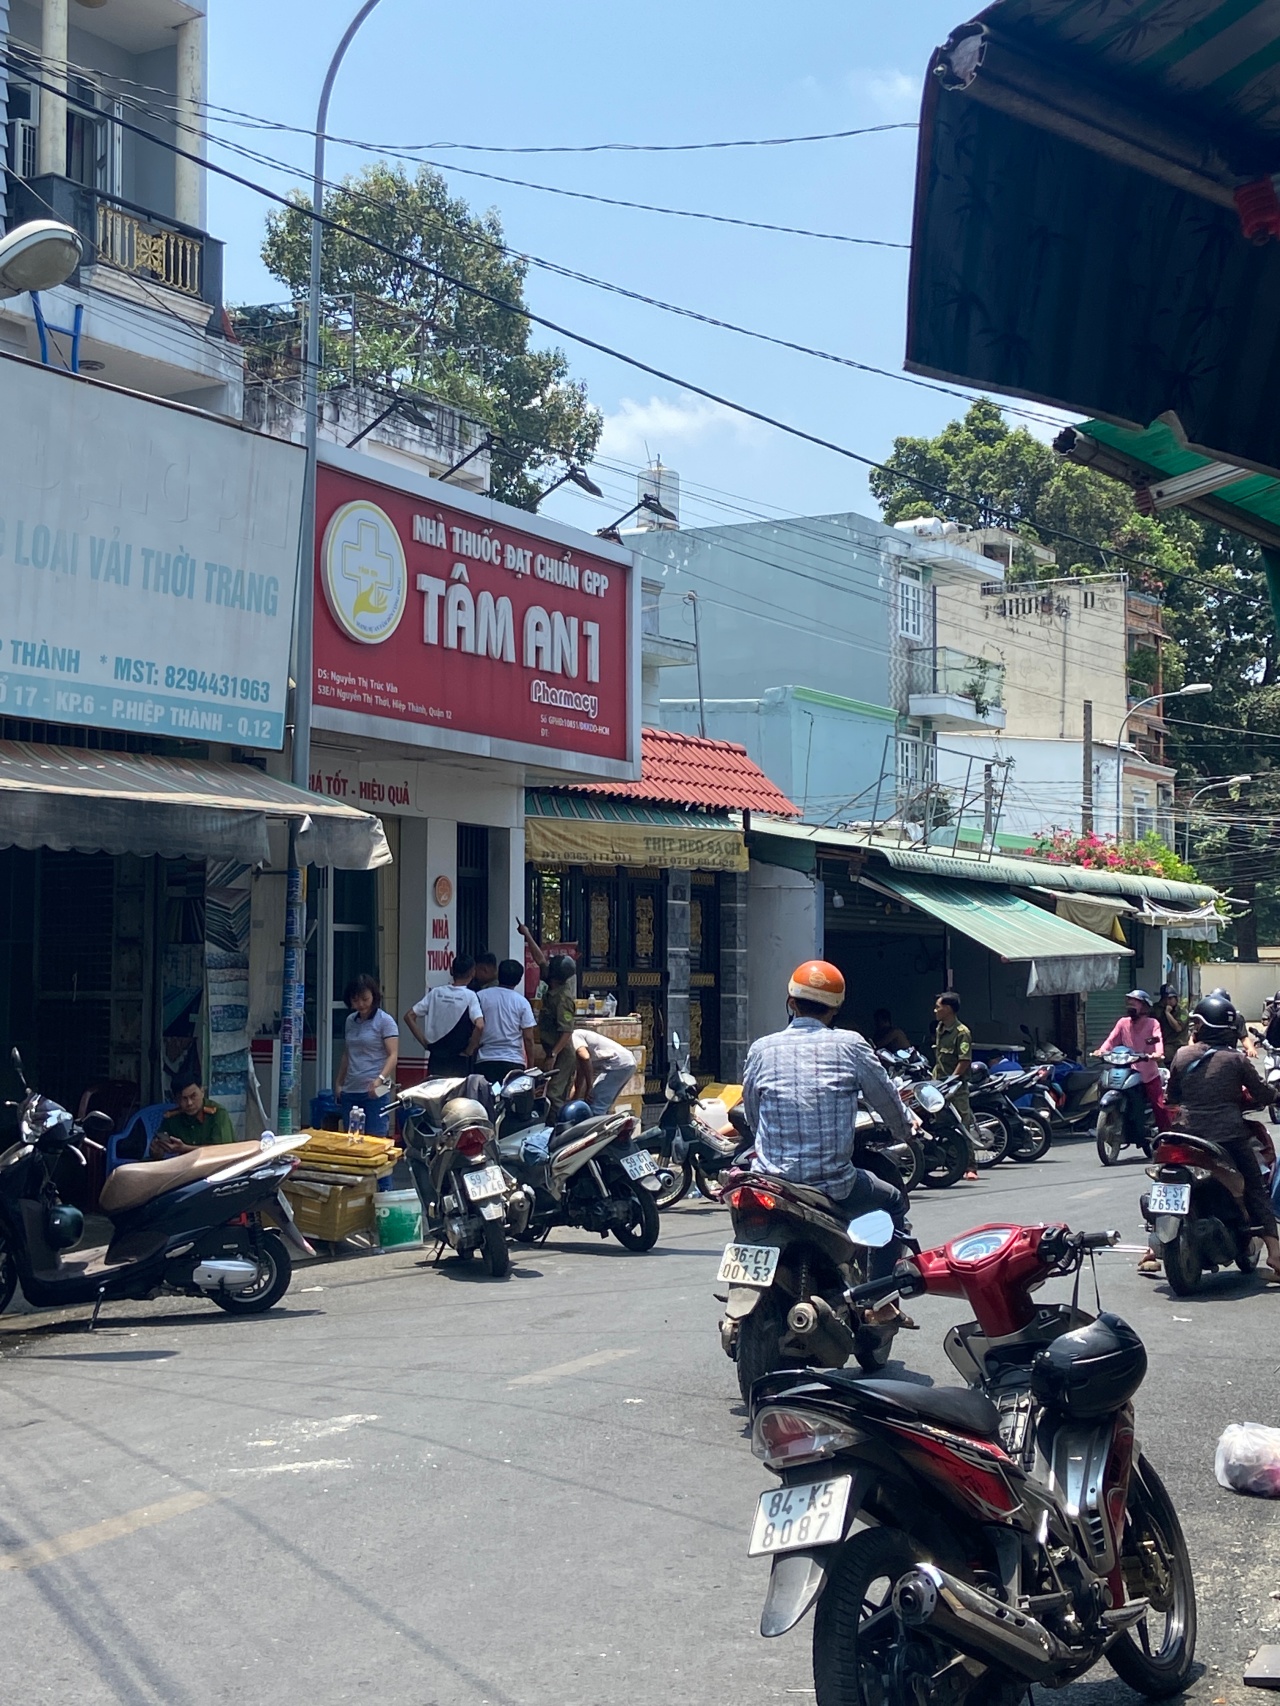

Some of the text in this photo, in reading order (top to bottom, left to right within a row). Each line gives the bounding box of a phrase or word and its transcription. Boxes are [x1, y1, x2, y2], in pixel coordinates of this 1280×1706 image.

[14, 520, 80, 583] LOẠI
[90, 526, 132, 587] VẢI
[141, 545, 196, 600] THỜI
[204, 562, 279, 617] TRANG
[412, 513, 609, 598] NHÀ THUỐC ĐẠT CHUẨN GPP
[416, 562, 516, 664] TÂM
[523, 605, 579, 679] AN
[583, 620, 600, 684] 1
[11, 639, 271, 703] THÀNH MST: 8294431963
[13, 685, 38, 707] 17
[55, 690, 95, 714] KP.6
[112, 698, 165, 726] P.HIỆP
[170, 706, 223, 732] THÀNH
[238, 717, 271, 739] Q.12
[446, 709, 453, 720] 12
[530, 679, 598, 719] Pharmacy
[308, 769, 323, 794] IÁ
[325, 769, 348, 797] TỐT
[359, 778, 385, 805] HIỆU
[388, 781, 410, 807] QUẢ
[643, 836, 675, 856] THỊT
[678, 838, 704, 853] HEO
[432, 913, 449, 939] NHÀ
[1152, 1198, 1186, 1212] 765.54
[722, 1263, 771, 1283] 001.53
[731, 1247, 771, 1266] 36-C1
[768, 1482, 836, 1518] 84-K5
[762, 1512, 830, 1549] 8087
